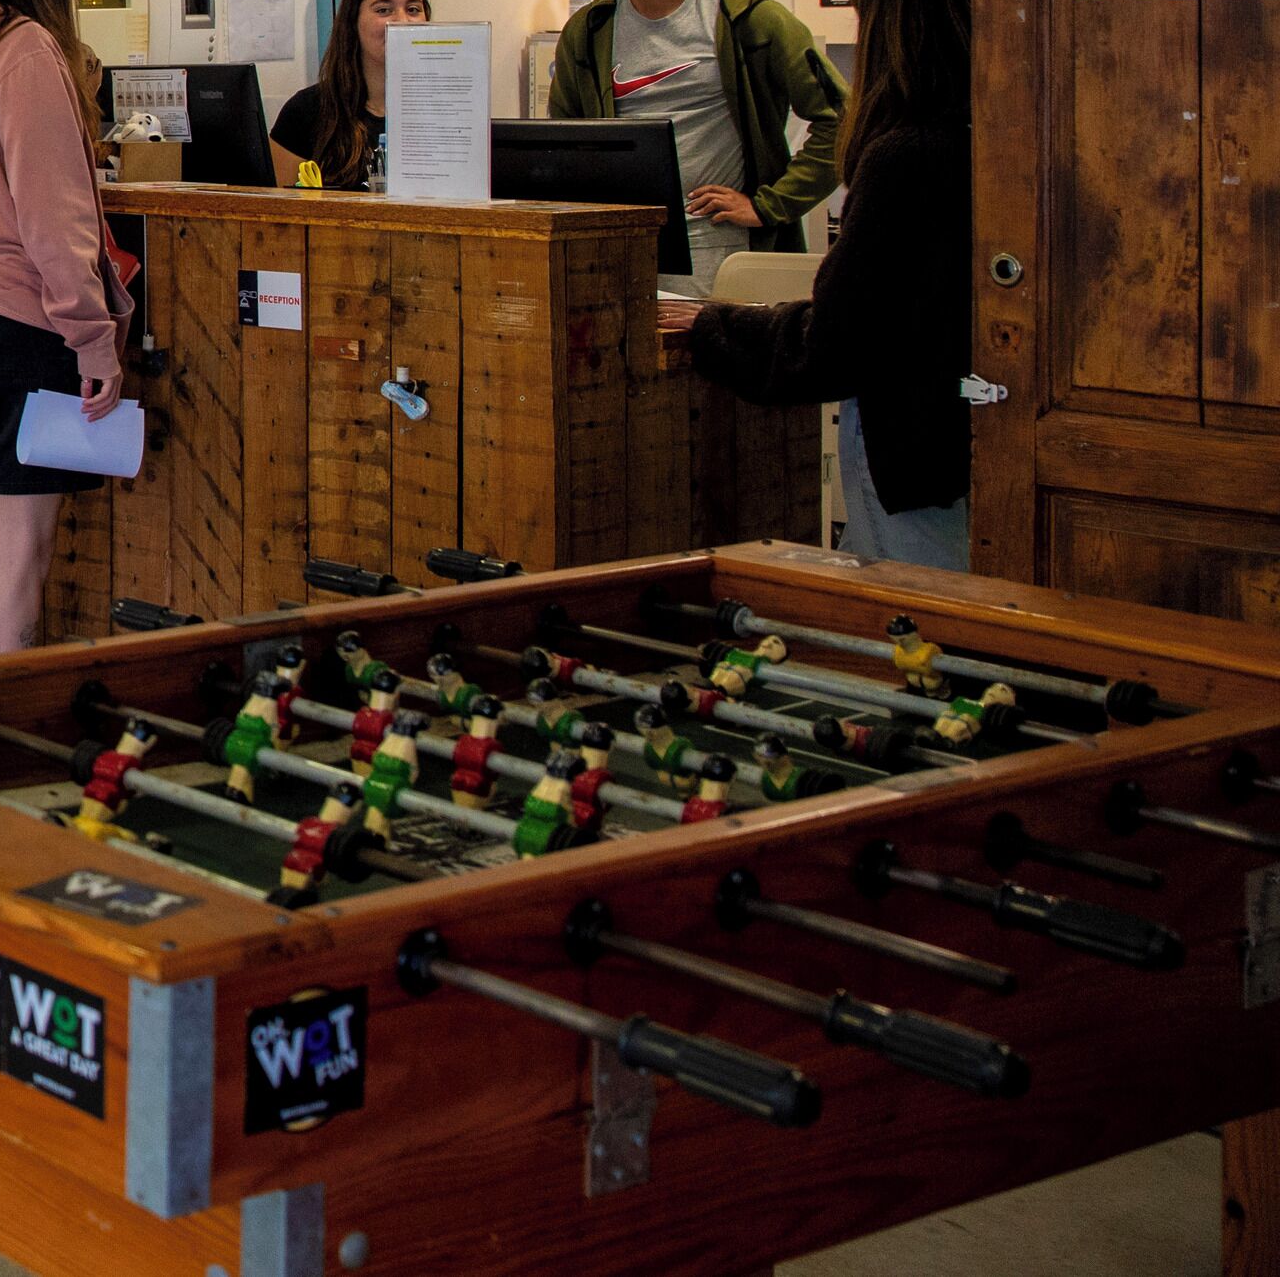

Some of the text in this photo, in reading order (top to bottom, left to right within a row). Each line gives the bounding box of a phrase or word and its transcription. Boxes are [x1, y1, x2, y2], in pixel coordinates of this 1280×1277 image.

[259, 295, 300, 306] RECEPTION
[9, 974, 102, 1058] WOT
[11, 1027, 23, 1046] A
[23, 1031, 69, 1067] GREAT
[254, 1004, 354, 1089] WOT
[315, 1049, 359, 1087] FUN
